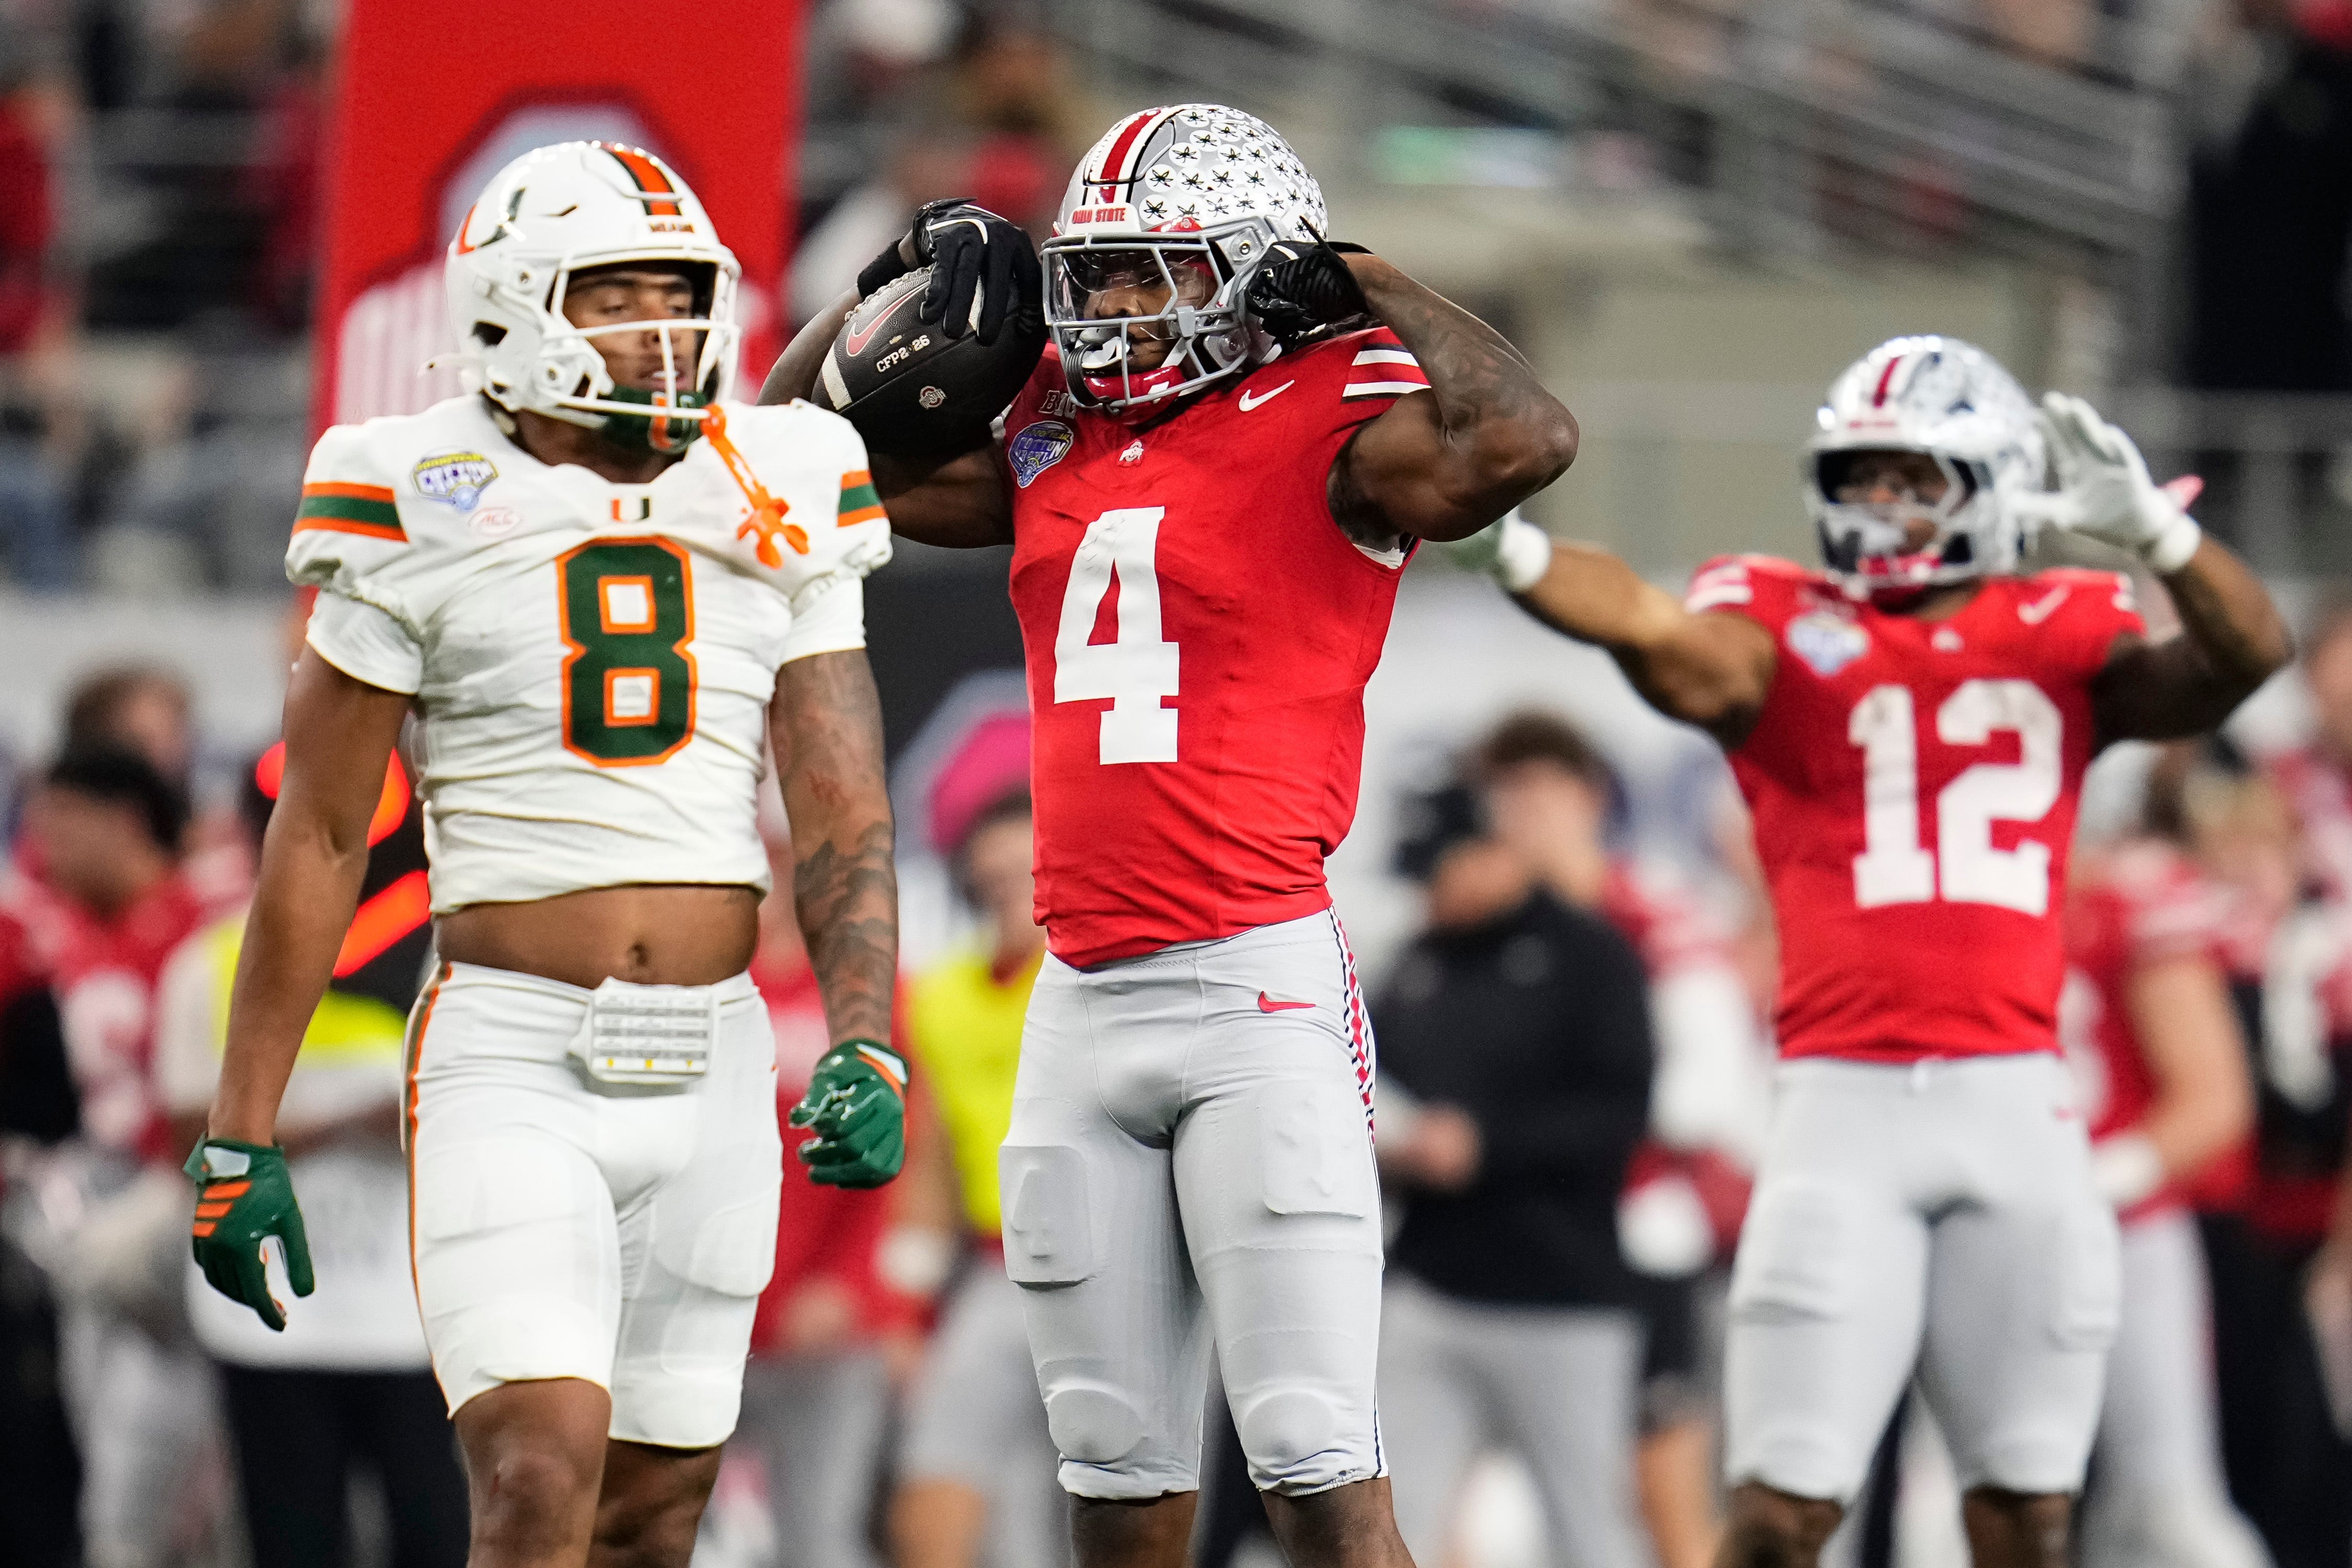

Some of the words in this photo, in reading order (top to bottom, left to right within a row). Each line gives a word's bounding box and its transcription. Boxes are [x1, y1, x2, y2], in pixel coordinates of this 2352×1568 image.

[1096, 207, 1126, 222] STATE
[556, 534, 699, 768] 8
[1054, 505, 1180, 765] 4
[1848, 678, 2065, 917] 12
